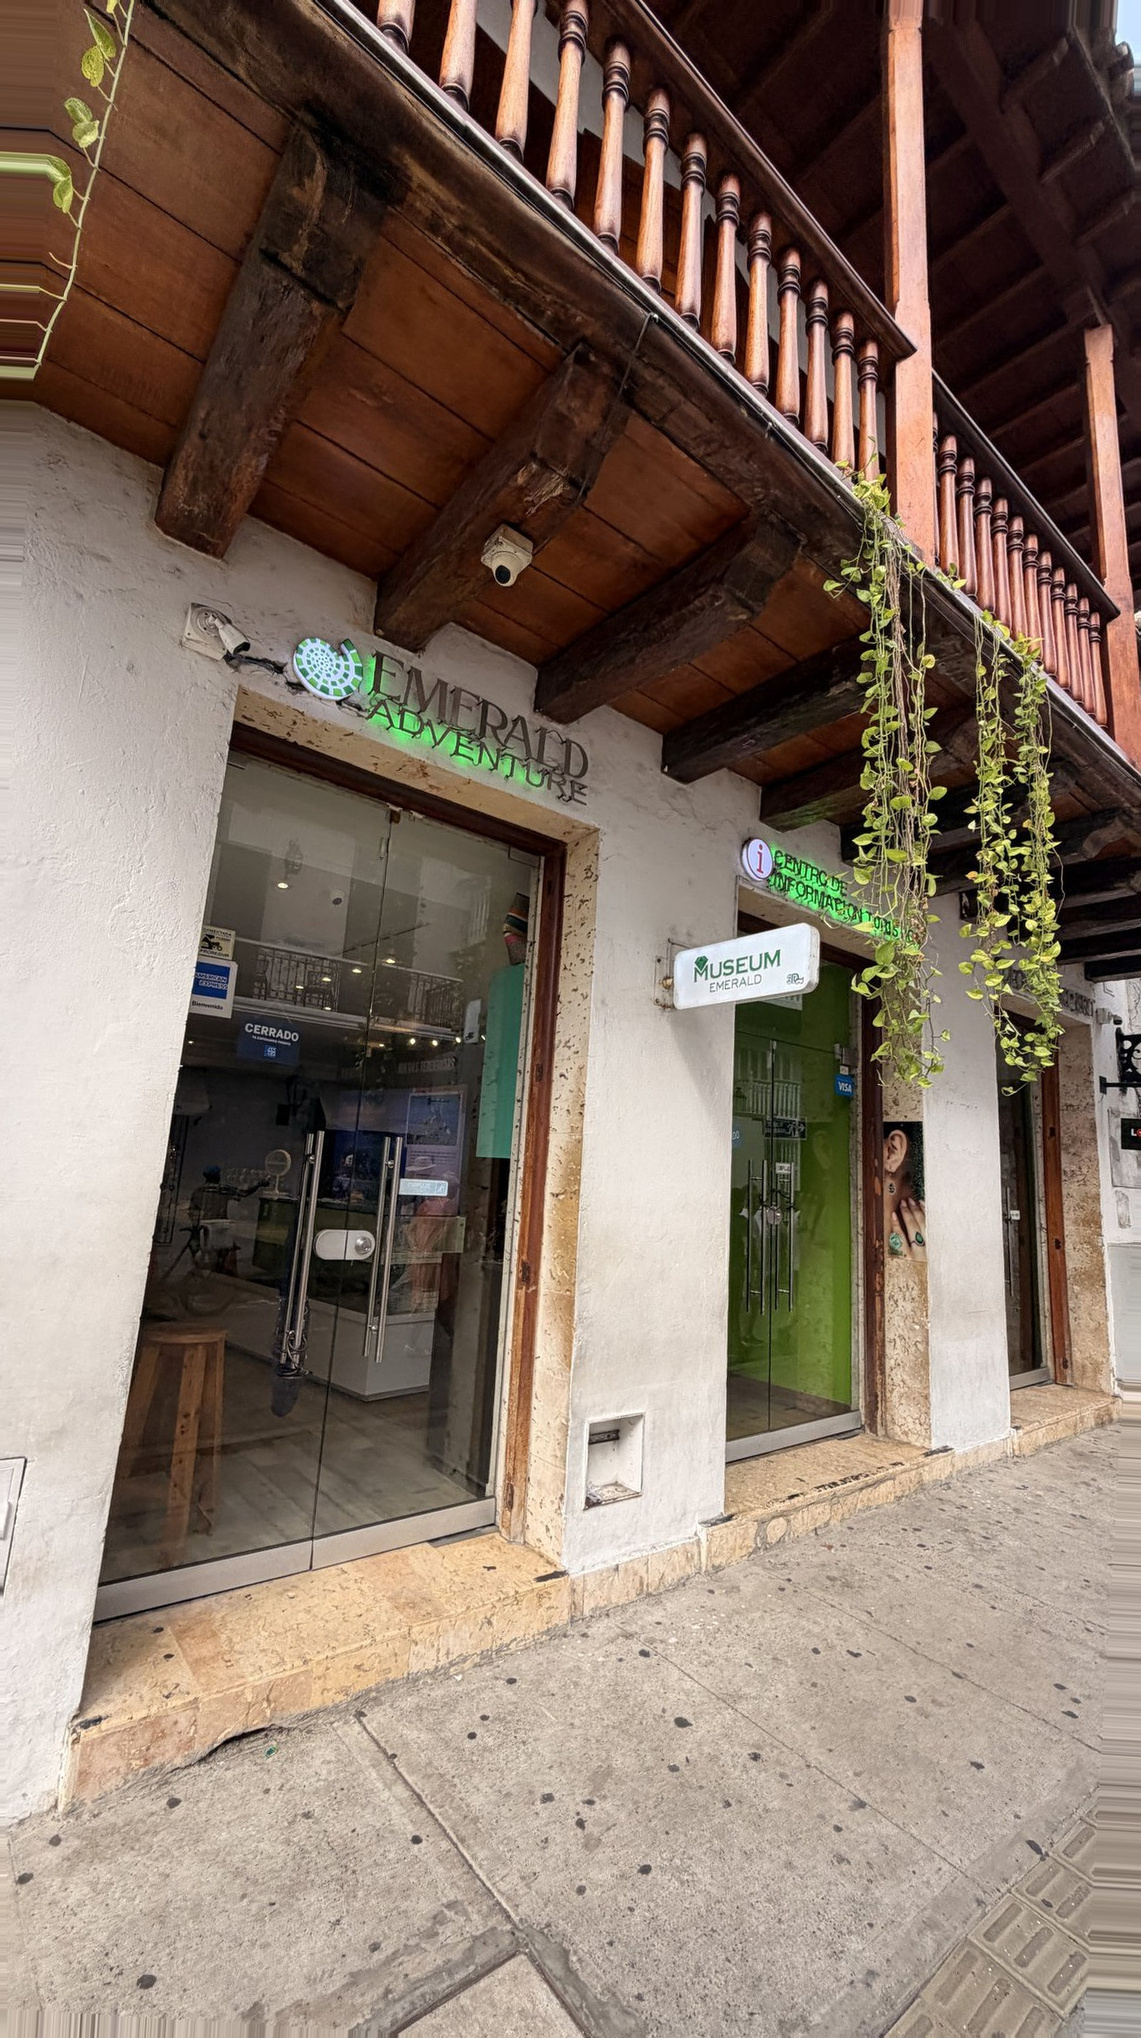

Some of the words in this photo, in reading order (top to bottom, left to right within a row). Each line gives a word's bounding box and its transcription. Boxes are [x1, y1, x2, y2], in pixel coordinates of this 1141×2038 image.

[367, 650, 589, 779] EMERALD
[365, 697, 589, 806] ADVENTURE
[831, 876, 849, 897] DE
[693, 949, 782, 983] MUSEUM
[709, 973, 763, 993] EMERALD
[244, 1022, 300, 1042] CERRADO
[838, 1081, 852, 1093] VISA
